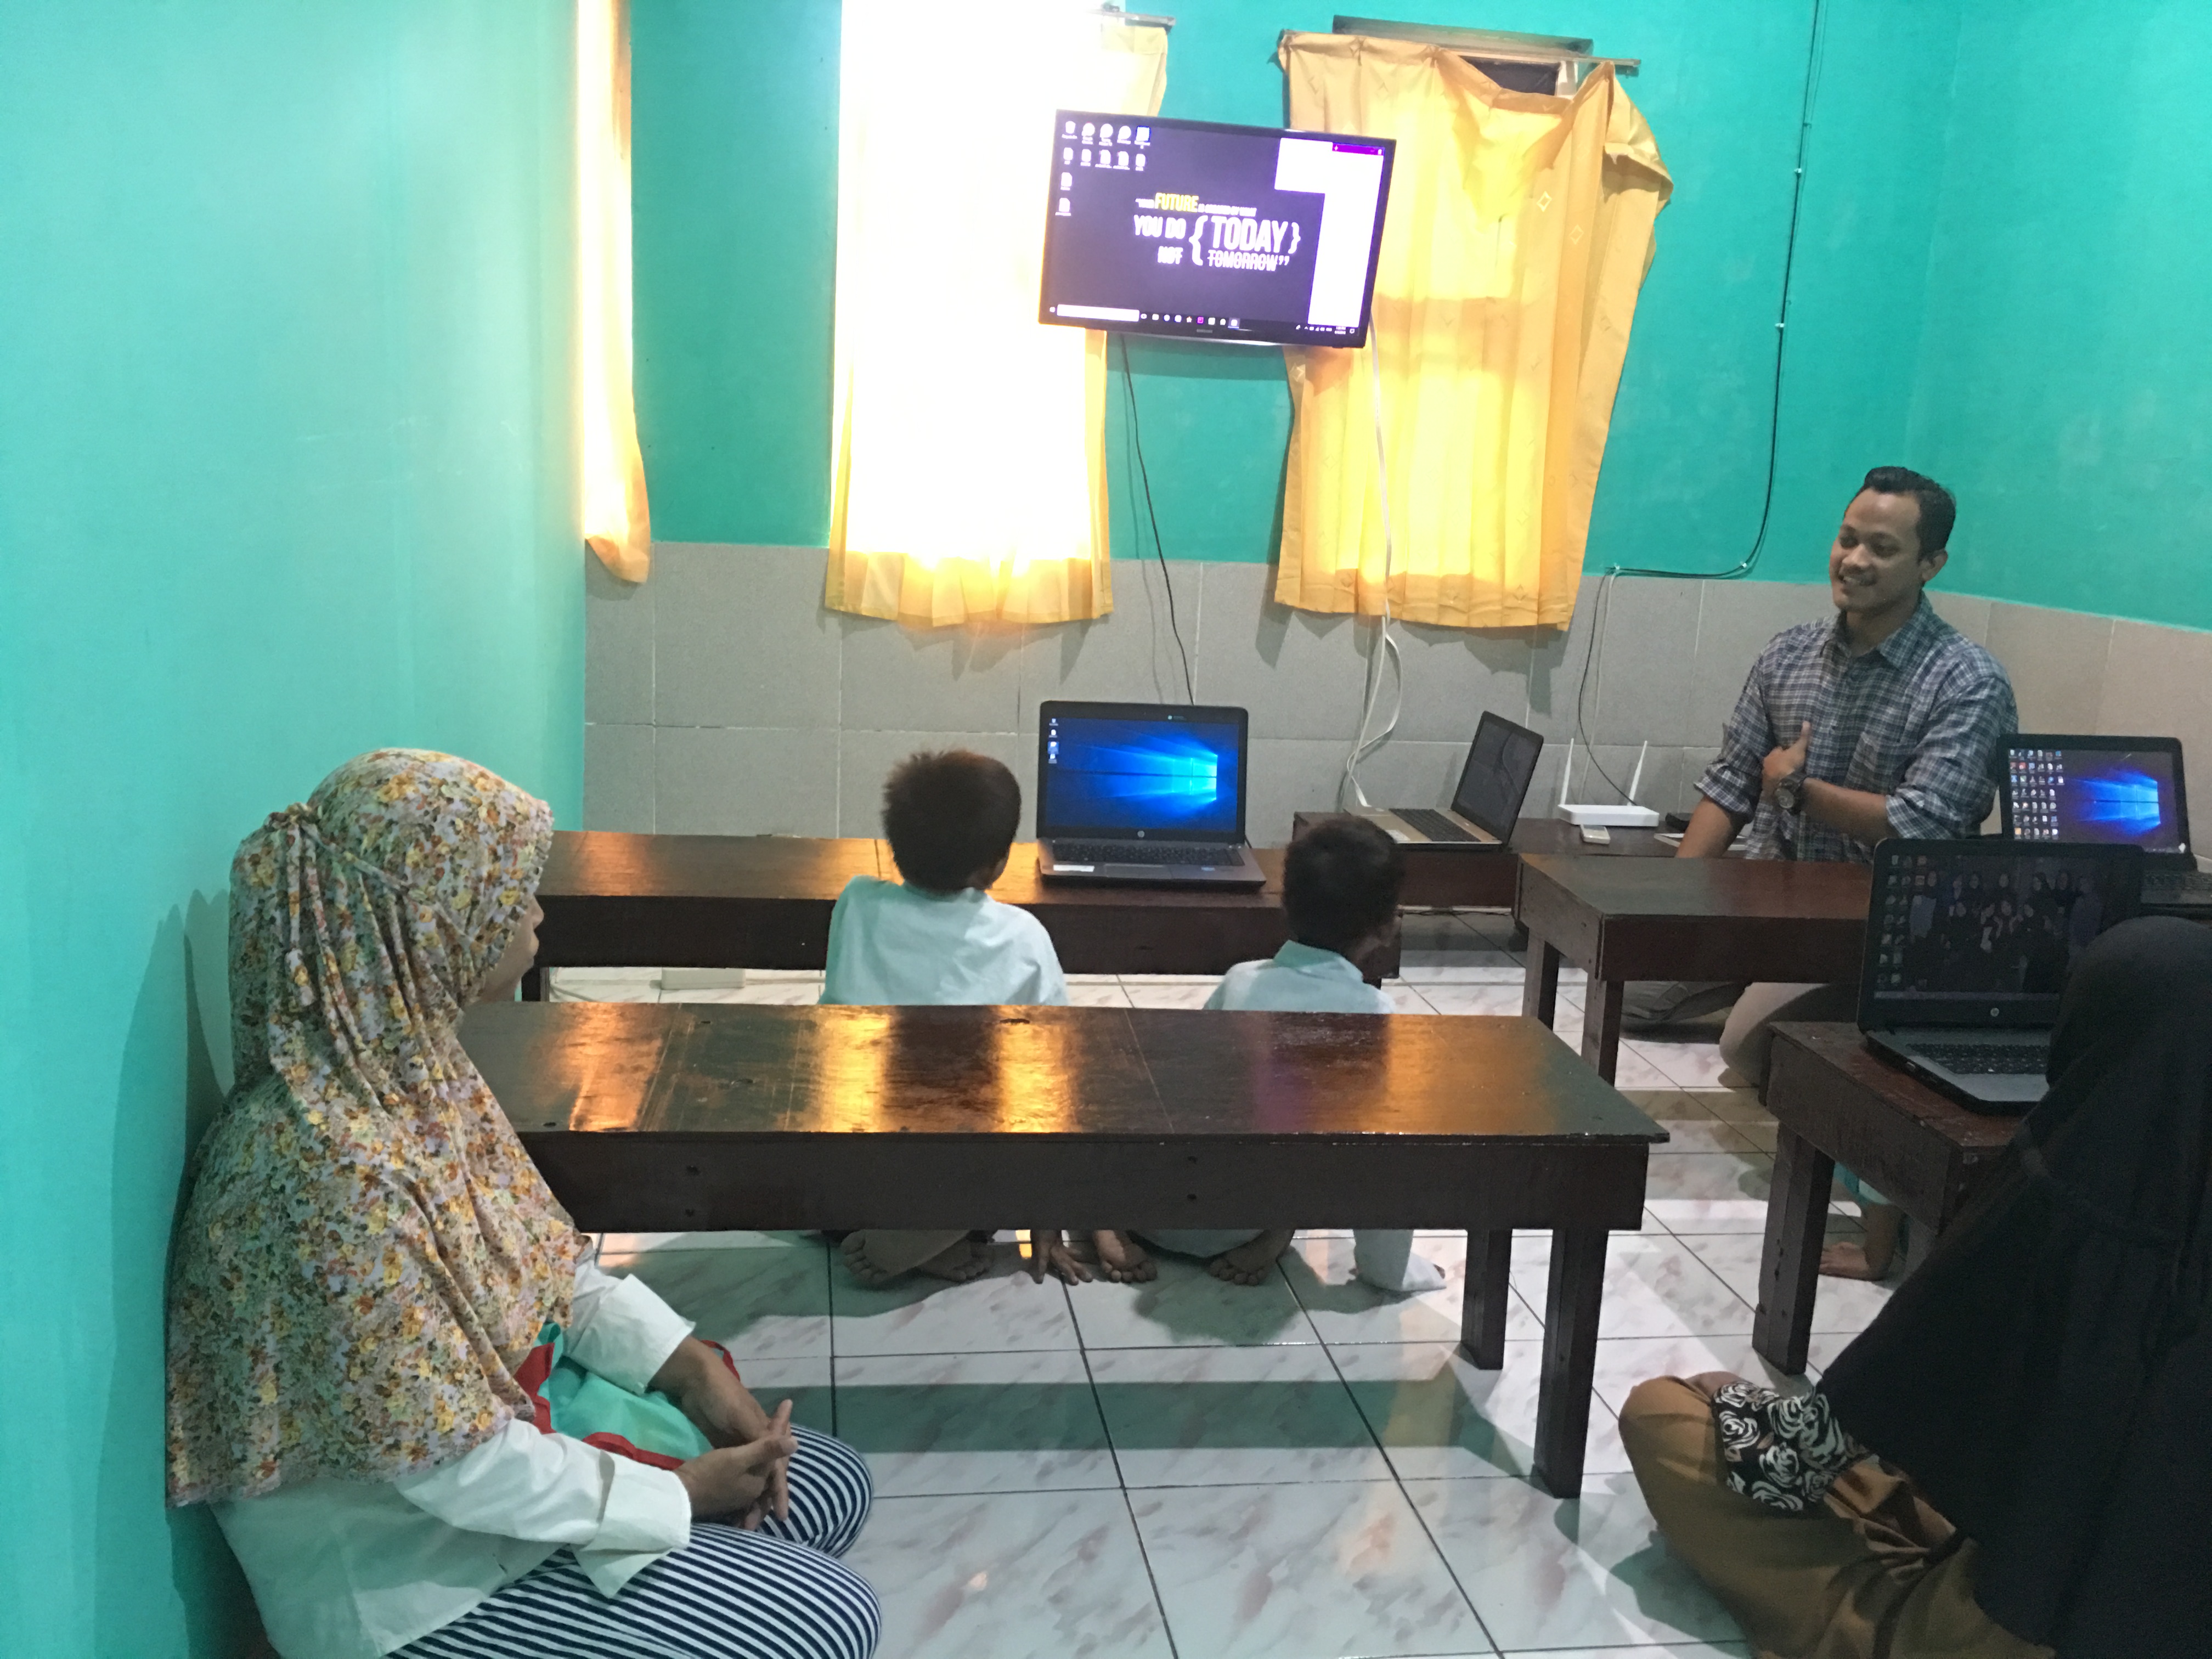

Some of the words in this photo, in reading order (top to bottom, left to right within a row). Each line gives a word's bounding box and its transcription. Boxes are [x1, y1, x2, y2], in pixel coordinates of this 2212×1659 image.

[1154, 193, 1199, 212] FUTURE
[1133, 215, 1163, 238] YOU
[1165, 217, 1186, 239] DO
[1211, 215, 1288, 253] TODAY
